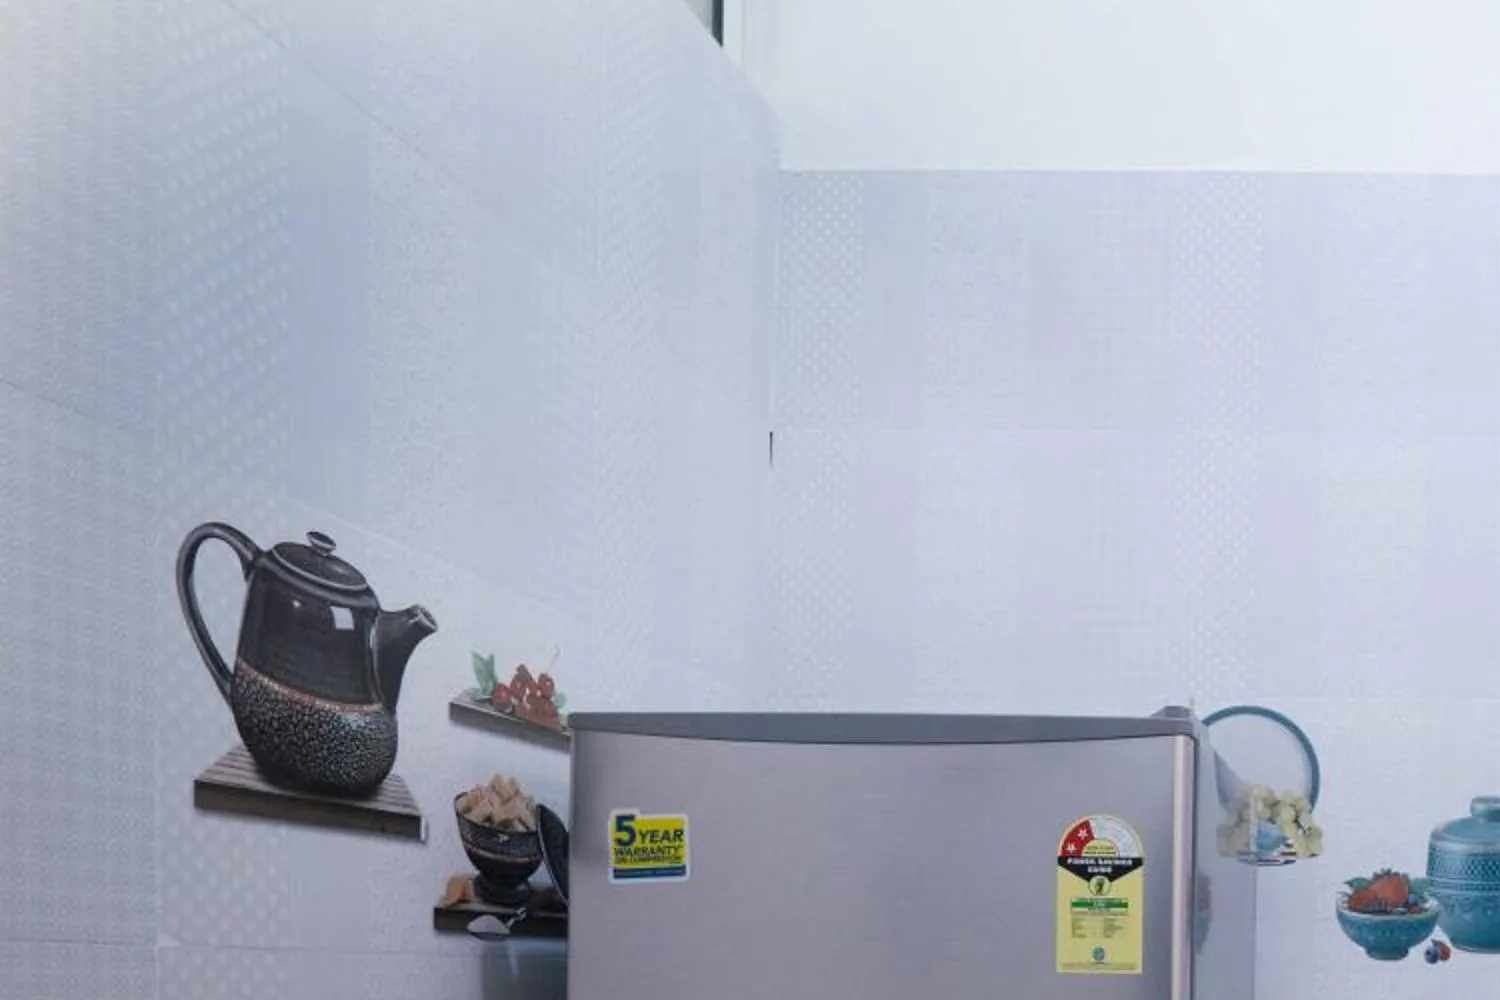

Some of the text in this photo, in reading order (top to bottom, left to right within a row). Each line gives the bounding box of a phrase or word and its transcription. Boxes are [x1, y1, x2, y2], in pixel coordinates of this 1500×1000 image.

[614, 814, 685, 847] 5 YEAR
[613, 845, 680, 857] WARRANTY
